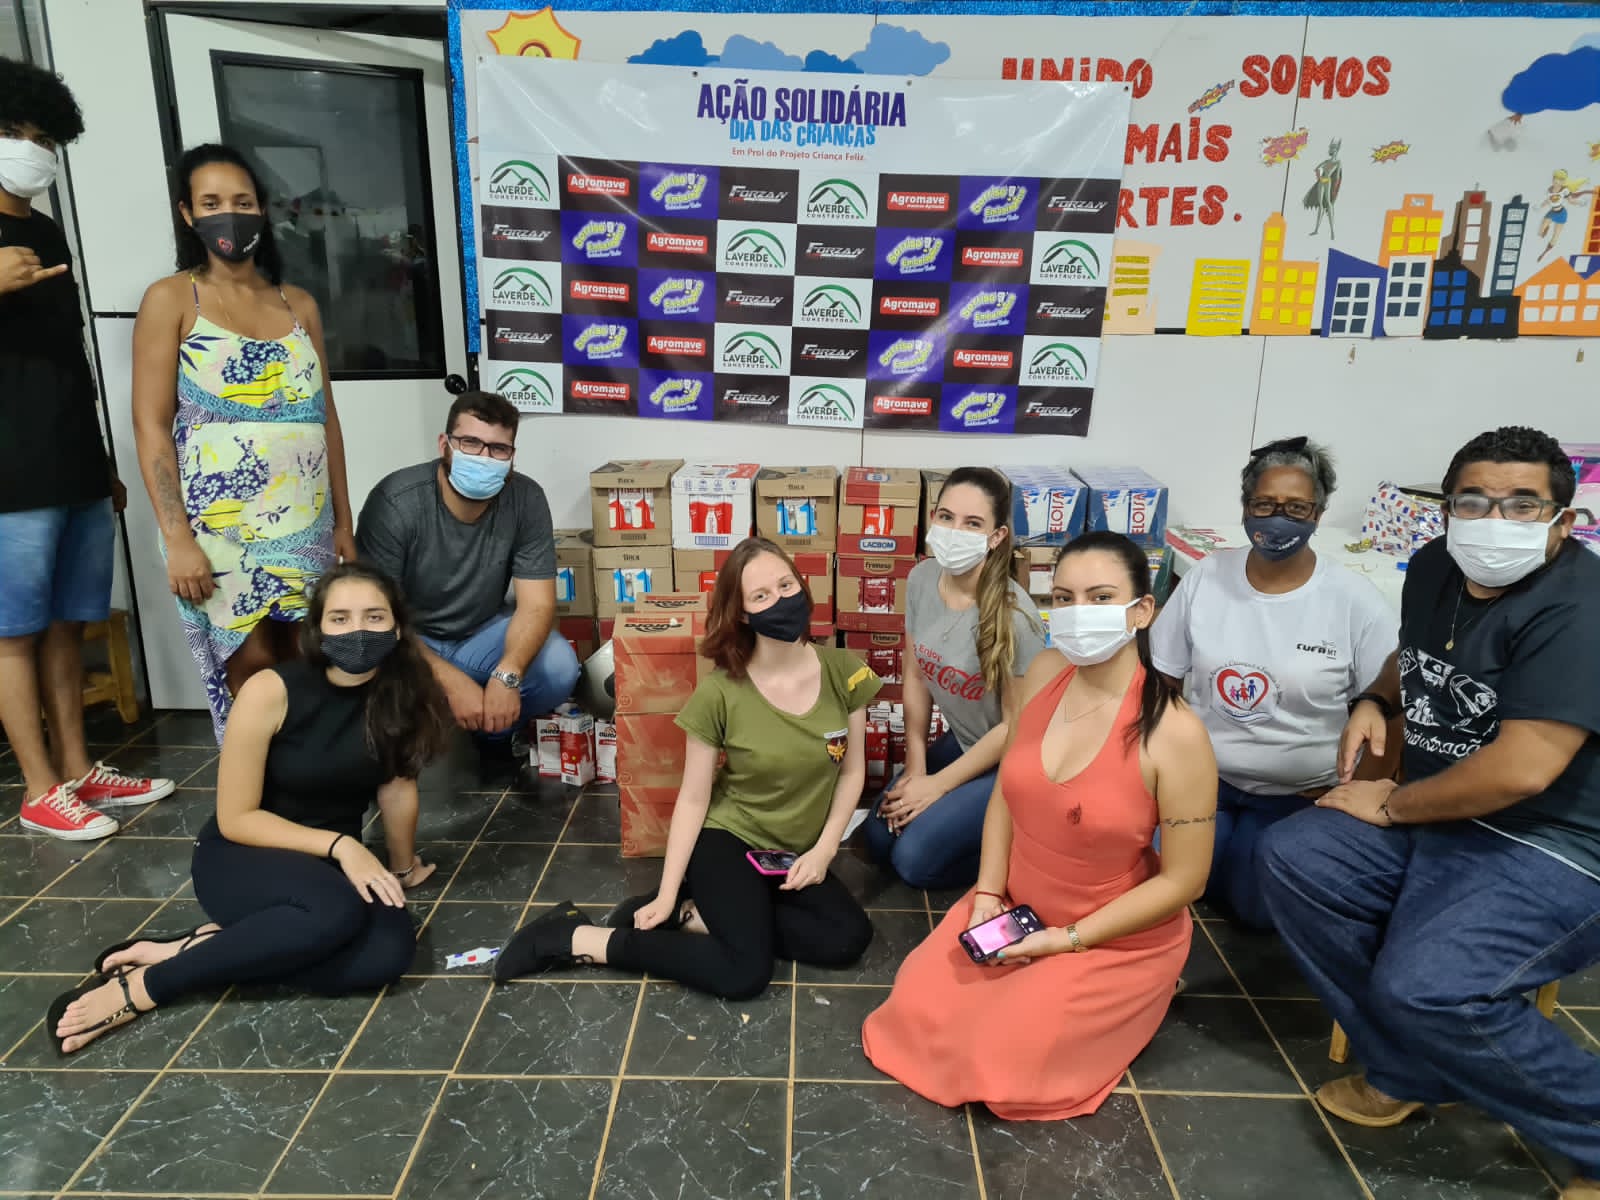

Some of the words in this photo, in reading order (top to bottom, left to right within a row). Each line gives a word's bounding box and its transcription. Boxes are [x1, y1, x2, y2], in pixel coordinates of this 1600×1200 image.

[1239, 54, 1392, 100] SOMOS
[697, 78, 767, 124] AÇÃO
[774, 84, 907, 127] SOLIDÁRIA
[729, 119, 756, 143] DIA
[760, 119, 792, 143] DAS
[796, 122, 876, 148] CRIANÇAS
[732, 147, 745, 156] Em
[748, 148, 764, 157] Prol
[767, 149, 778, 158] do
[780, 150, 810, 160] Projeto
[812, 151, 843, 162] Criança
[571, 175, 624, 189] Agromave
[490, 185, 533, 195] LAVERDE
[890, 193, 944, 205] Agromave
[807, 204, 850, 214] LAVERDE
[1116, 185, 1242, 228] RTES.
[651, 233, 703, 246] Agromave
[726, 252, 768, 262] LAVERDE
[966, 249, 1018, 261] Agromave
[1040, 264, 1083, 274] LAVERDE
[573, 282, 624, 294] Agromave
[492, 290, 535, 300] LAVERDE
[883, 298, 935, 310] Agromave
[802, 308, 844, 317] LAVERDE
[651, 337, 701, 349] Agromave
[723, 354, 765, 363] LAVERDE
[956, 351, 1009, 362] Agromave
[1029, 366, 1070, 374] LAVERDE
[574, 383, 626, 394] Agromave
[502, 391, 537, 400] AVERDE
[876, 399, 927, 410] Agromave
[797, 406, 838, 415] LAVERDE
